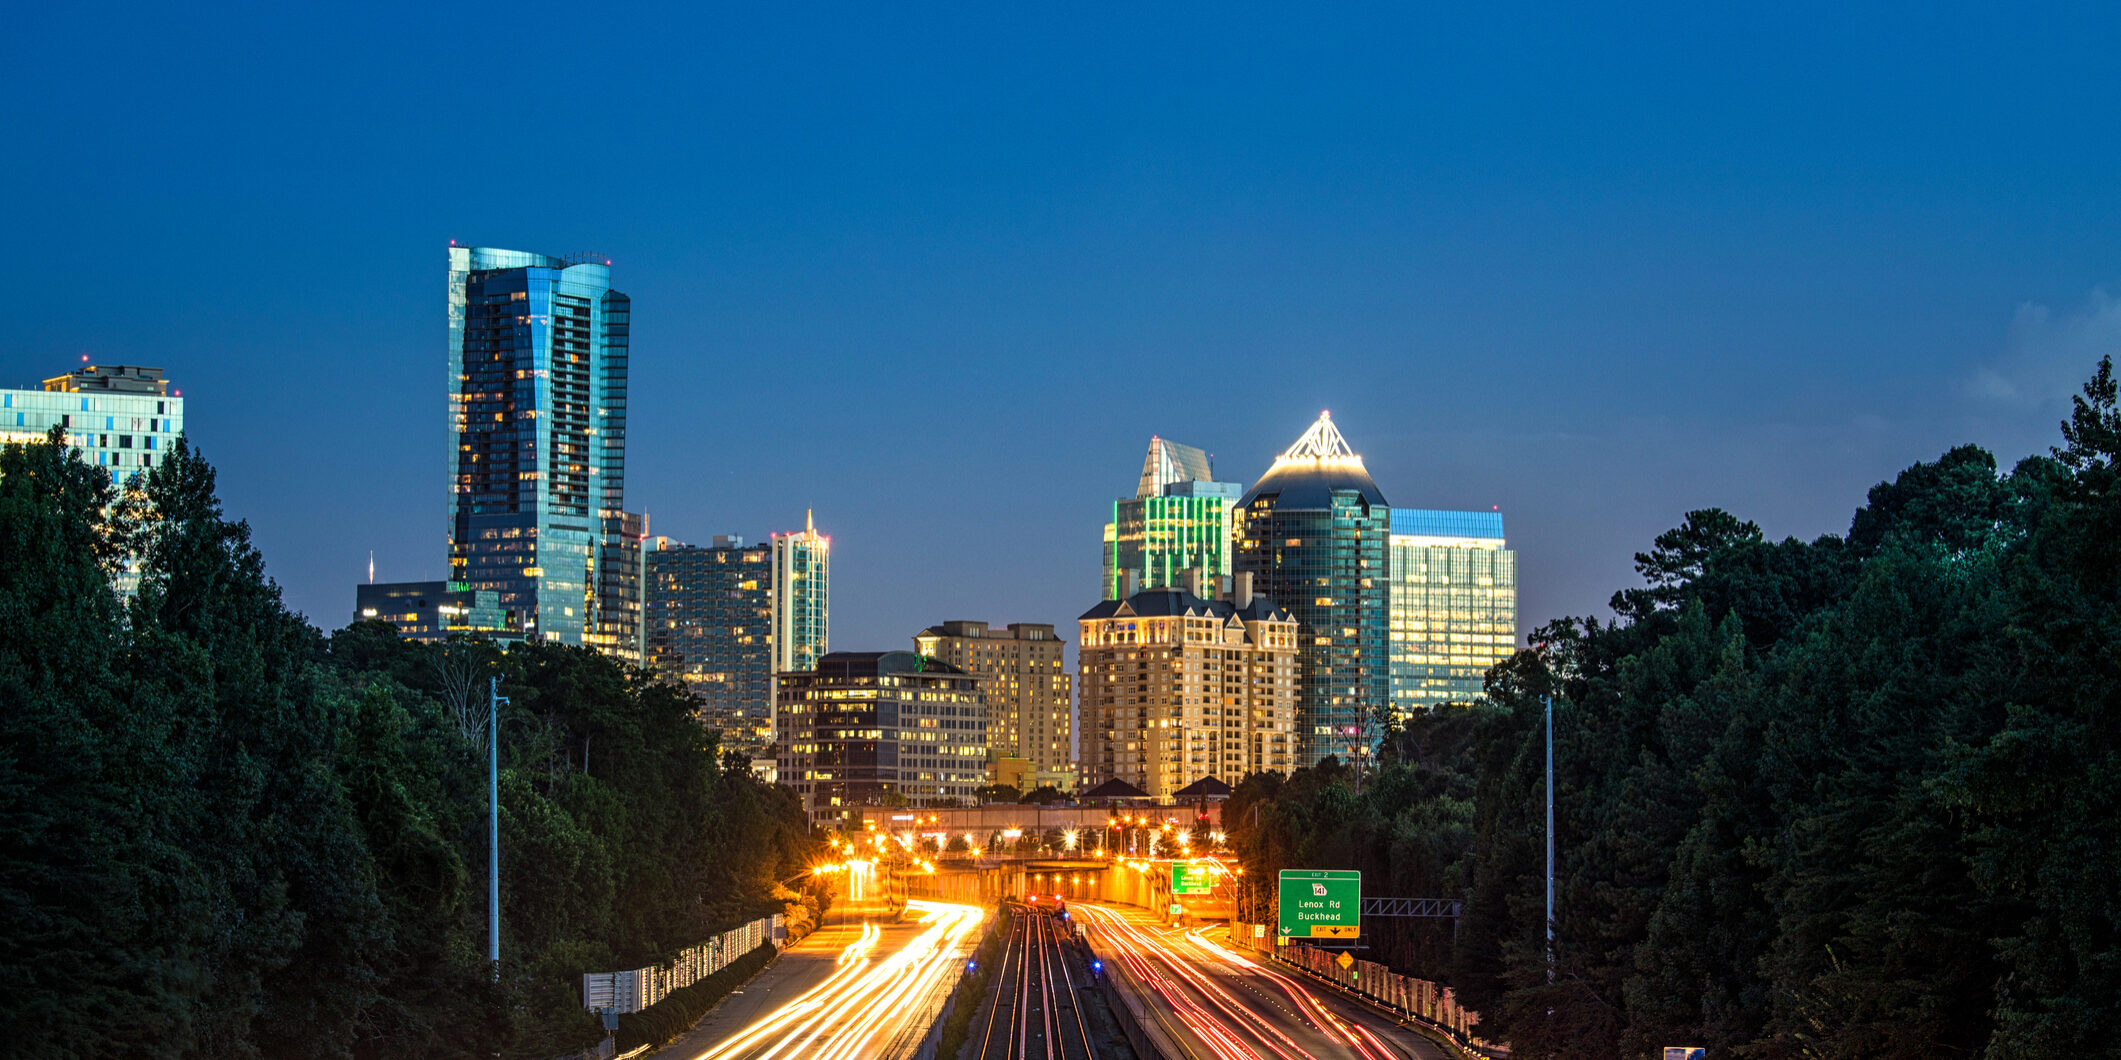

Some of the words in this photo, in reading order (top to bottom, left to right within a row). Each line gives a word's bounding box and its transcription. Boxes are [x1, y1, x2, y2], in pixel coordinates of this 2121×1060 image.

[1299, 900, 1324, 908] Lenox
[1329, 900, 1340, 908] Rd
[1298, 912, 1341, 920] Buckhead
